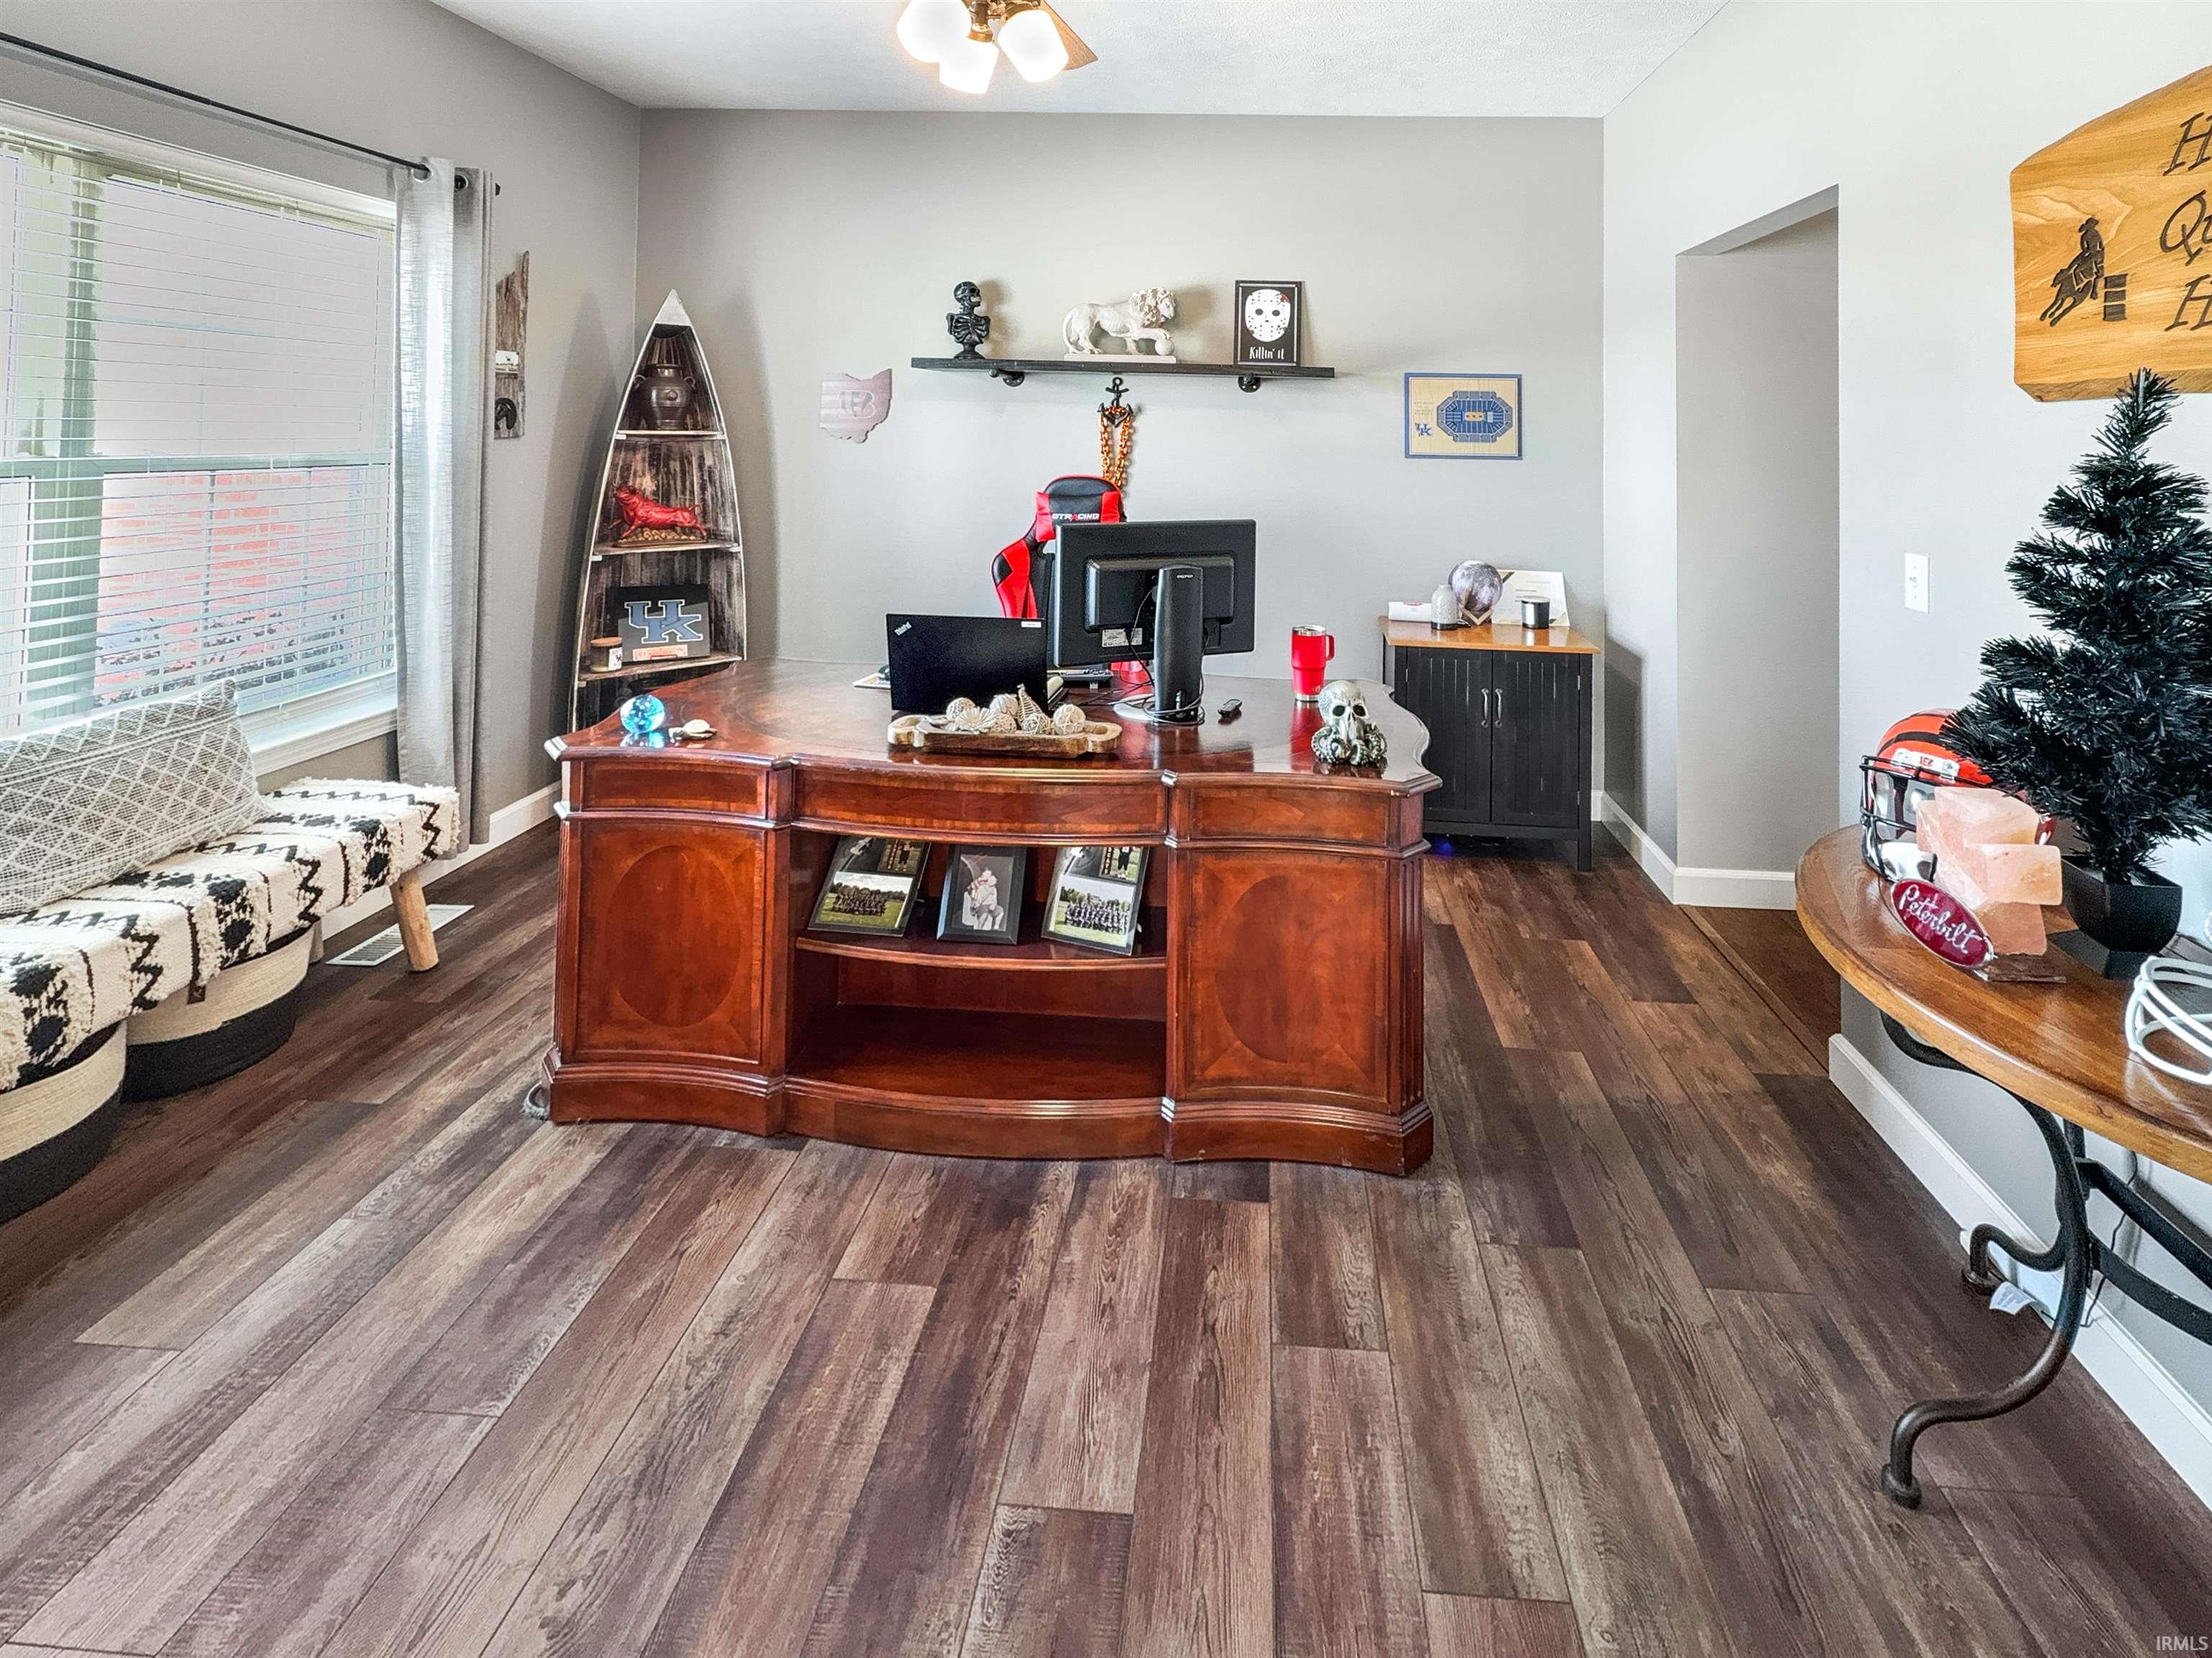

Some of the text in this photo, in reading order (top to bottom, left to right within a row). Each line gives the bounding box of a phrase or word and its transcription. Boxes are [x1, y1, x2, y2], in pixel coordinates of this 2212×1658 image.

[1249, 346, 1285, 360] Killin' it
[1052, 513, 1100, 521] GTRACING
[624, 599, 703, 644] UK
[1899, 884, 1982, 954] Peterbilt
